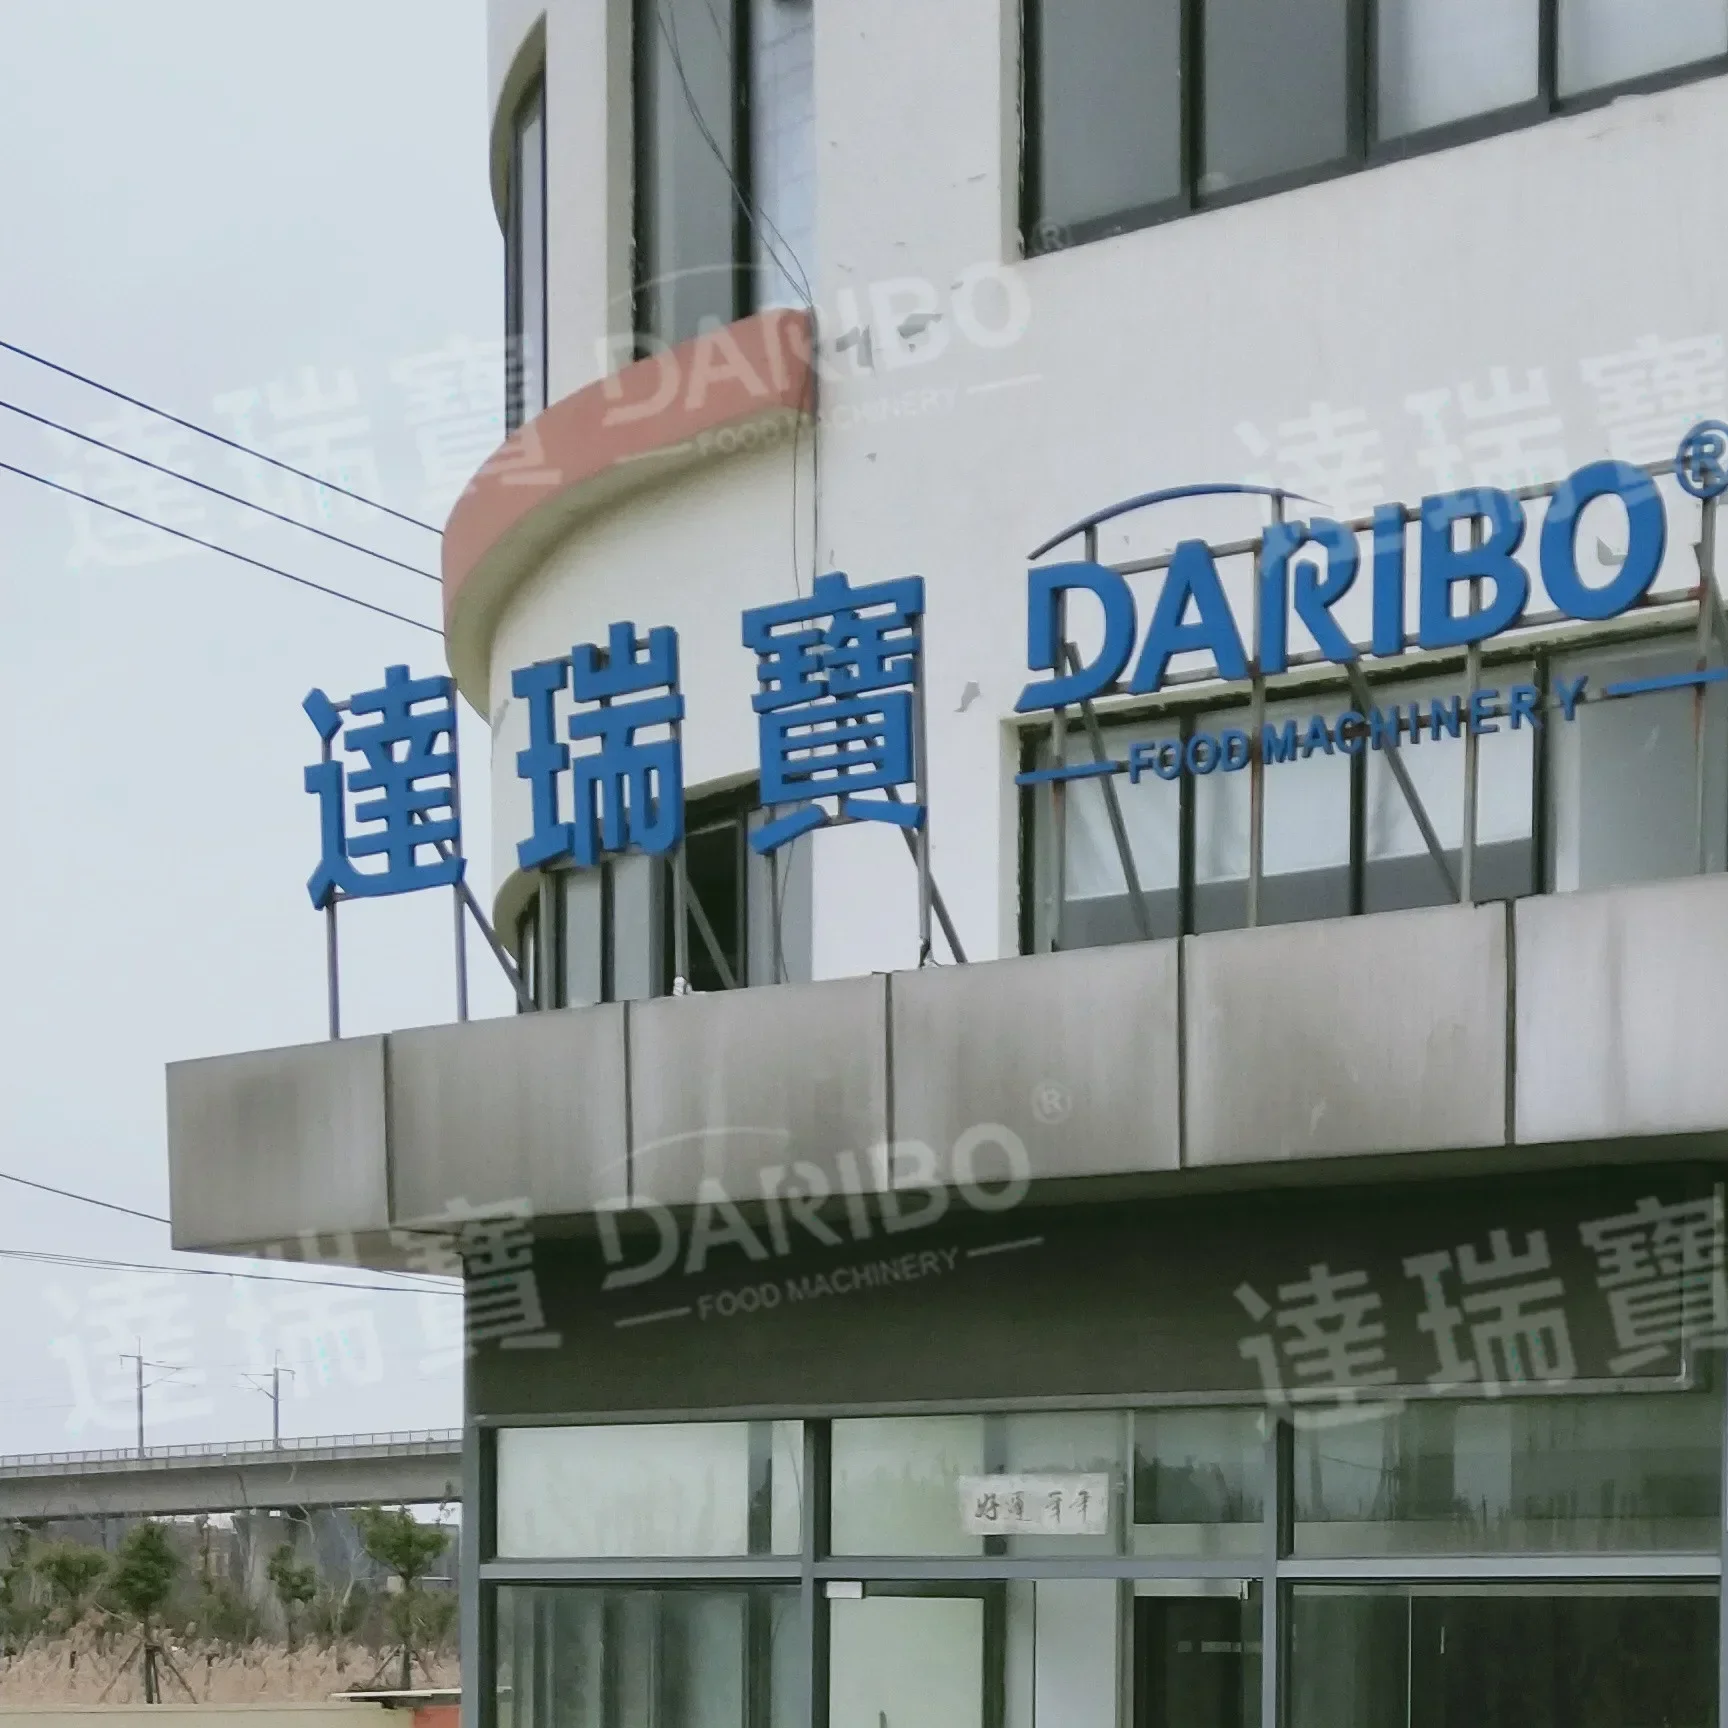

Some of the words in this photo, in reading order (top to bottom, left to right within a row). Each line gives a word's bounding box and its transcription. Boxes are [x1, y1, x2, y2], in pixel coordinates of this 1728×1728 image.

[1014, 459, 1667, 713] DARIBO
[303, 571, 927, 910] 達瑞寶
[1128, 729, 1248, 784] FOOD
[1260, 676, 1591, 766] MACHINERY
